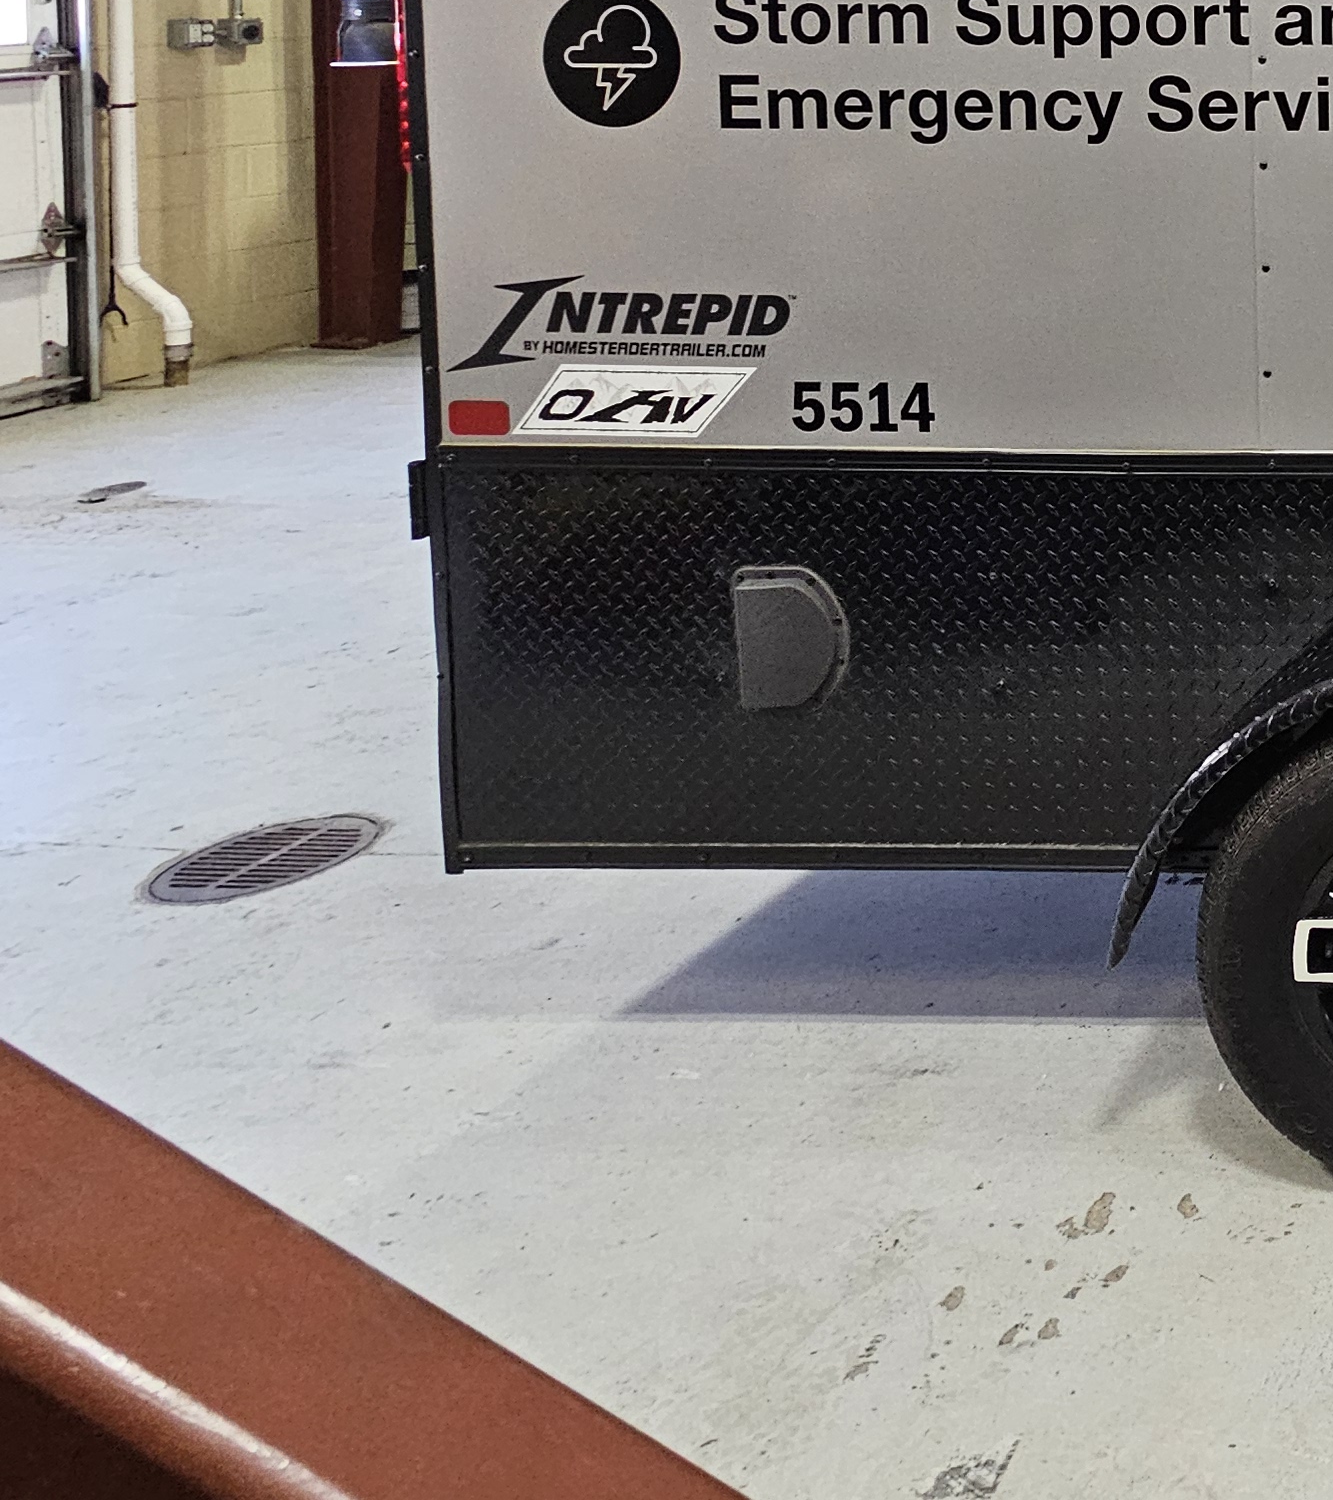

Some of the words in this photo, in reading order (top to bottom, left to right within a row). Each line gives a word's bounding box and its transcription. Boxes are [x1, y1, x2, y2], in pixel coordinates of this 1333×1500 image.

[718, 74, 1124, 145] Emergency
[523, 341, 540, 351] BY
[542, 340, 767, 358] HOMESTEADERTRAILER.COM
[791, 381, 936, 433] 5514
